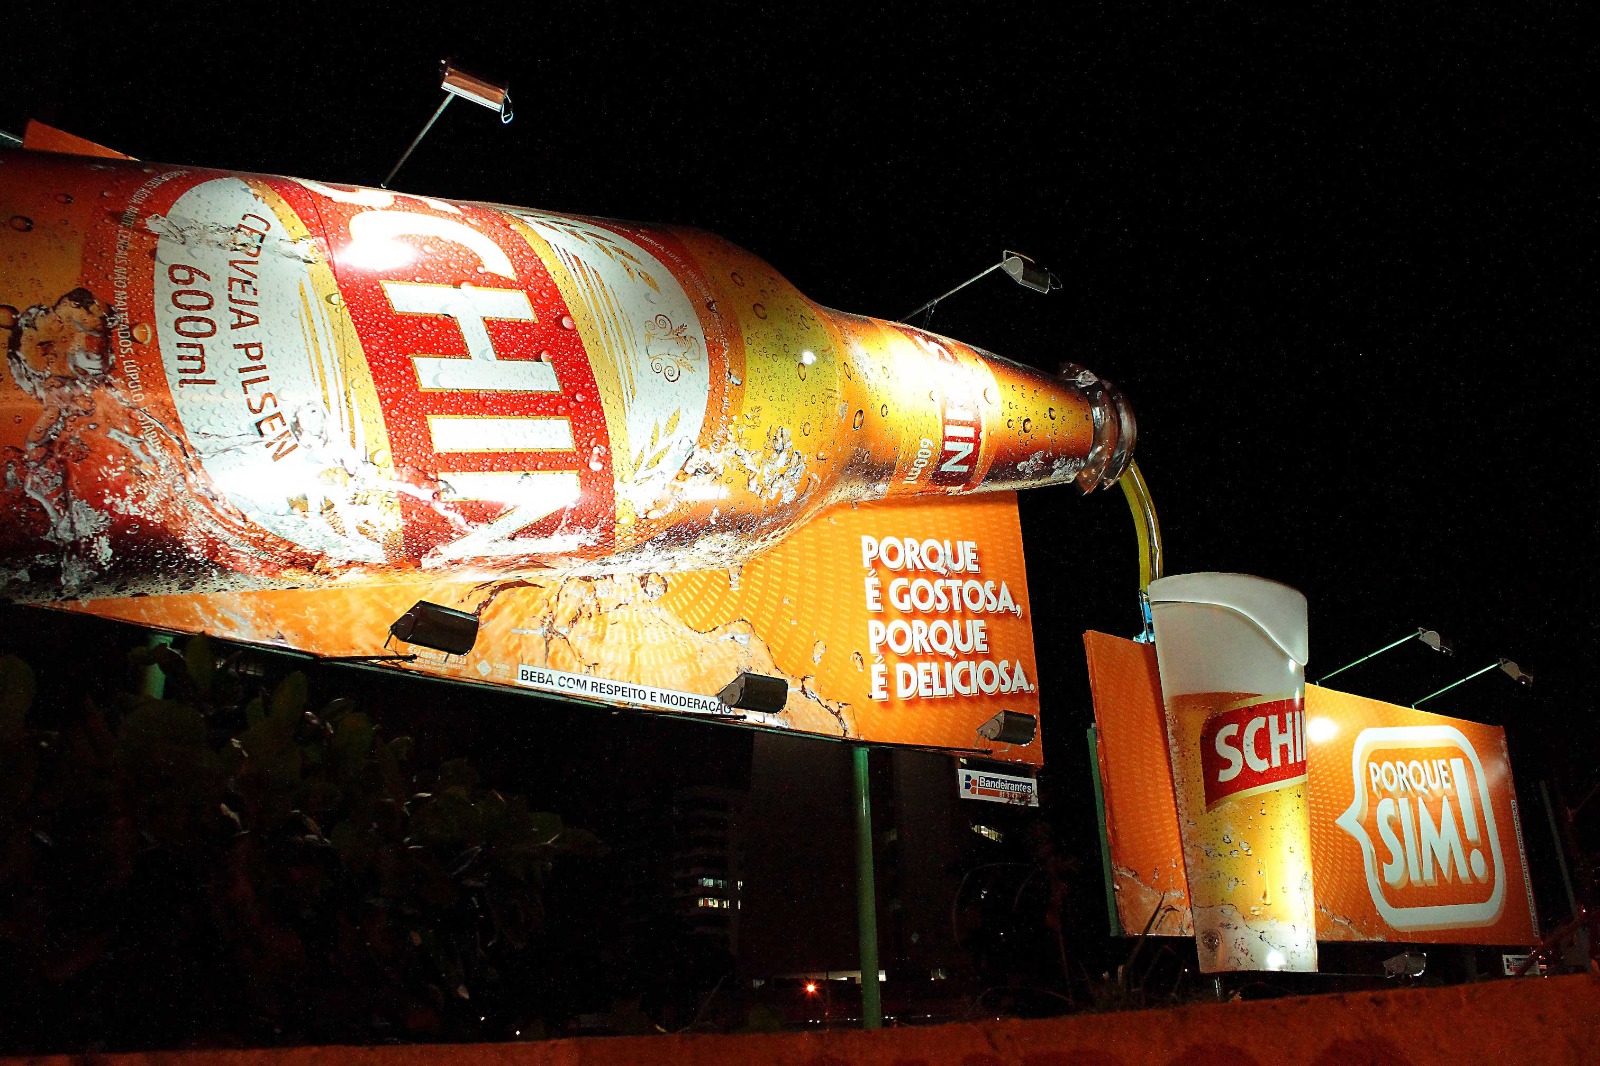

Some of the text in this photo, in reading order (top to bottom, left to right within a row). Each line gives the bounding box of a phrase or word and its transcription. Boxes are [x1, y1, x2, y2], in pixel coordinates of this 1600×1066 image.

[227, 212, 272, 330] CERVEJA
[168, 263, 217, 389] 600ml
[233, 341, 299, 462] PILSEN
[861, 535, 980, 576] PORQUE
[865, 569, 1022, 618] É GOSTOSA,
[868, 619, 989, 658] PORQUE
[521, 669, 554, 686] BEBA
[557, 675, 587, 691] COM
[590, 680, 647, 701] RESPEITO
[650, 691, 657, 703] E
[871, 656, 1035, 700] É DELICIOSA.
[979, 776, 1032, 793] Bandeirantes
[1369, 758, 1451, 794] PORQUE
